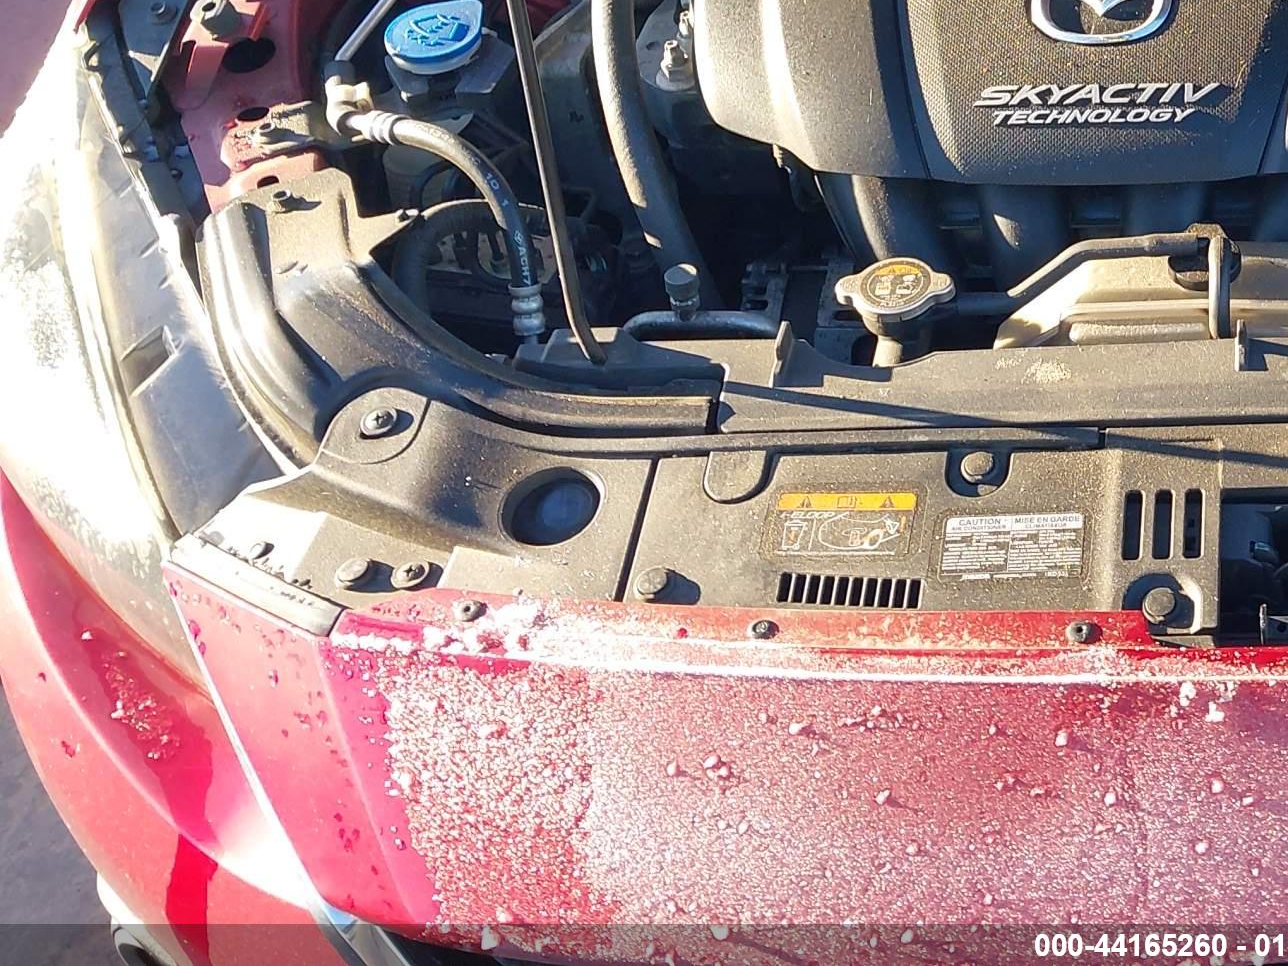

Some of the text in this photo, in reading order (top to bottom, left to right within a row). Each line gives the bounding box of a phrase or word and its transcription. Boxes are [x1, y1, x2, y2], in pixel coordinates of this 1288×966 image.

[973, 82, 1222, 107] SKYACTIV
[993, 107, 1197, 125] TECHNOLOGY
[958, 518, 1002, 526] CAUTION
[1050, 515, 1081, 523] GARDE
